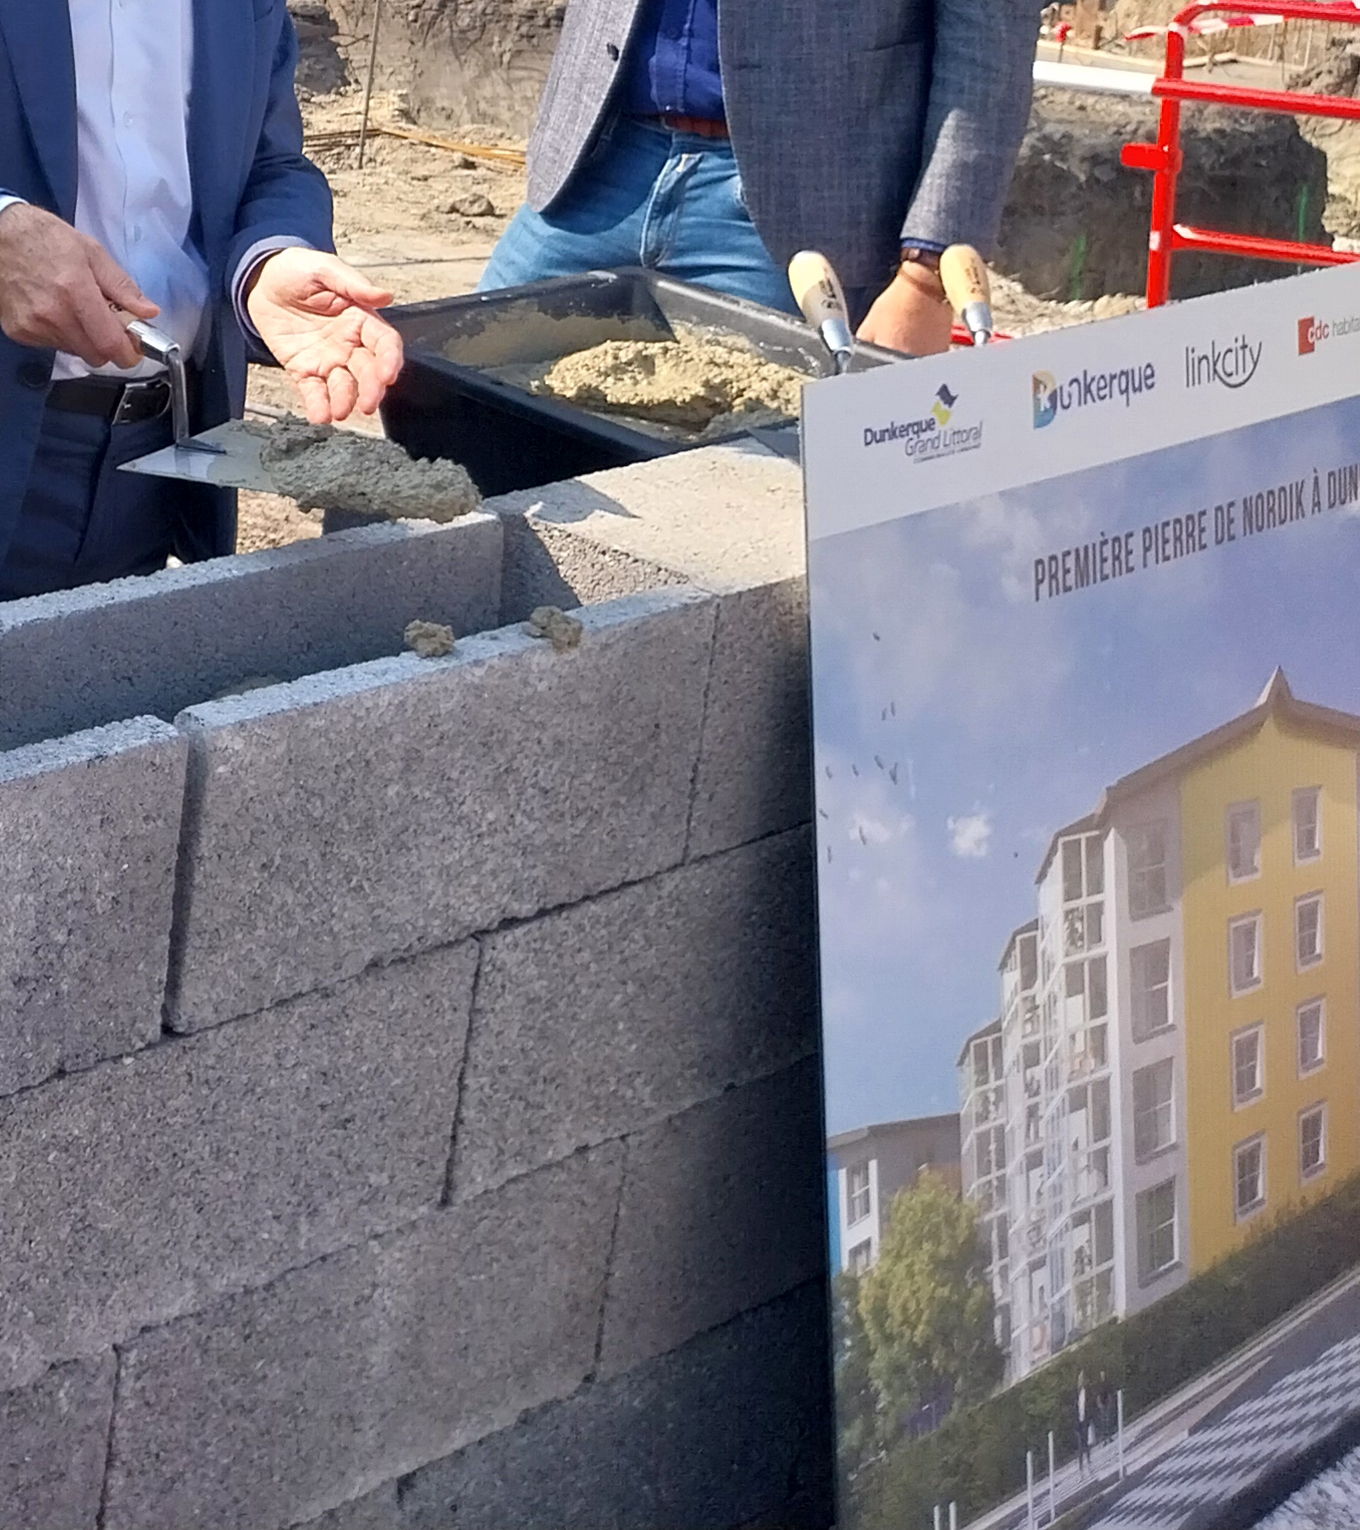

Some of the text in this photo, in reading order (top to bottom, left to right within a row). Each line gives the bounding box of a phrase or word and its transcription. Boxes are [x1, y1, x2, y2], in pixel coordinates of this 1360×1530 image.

[1308, 322, 1330, 344] cdc
[1185, 334, 1263, 389] linkcity
[1032, 362, 1156, 430] Dunkerque
[863, 417, 936, 447] Dunkerque
[905, 430, 941, 457] Grand
[943, 420, 983, 447] Littoral
[1034, 531, 1136, 602] PREMIÈRE
[1141, 508, 1208, 569] PIERRE
[1214, 500, 1236, 547] DE
[1242, 478, 1306, 537] NORDIK
[1311, 467, 1322, 515] À
